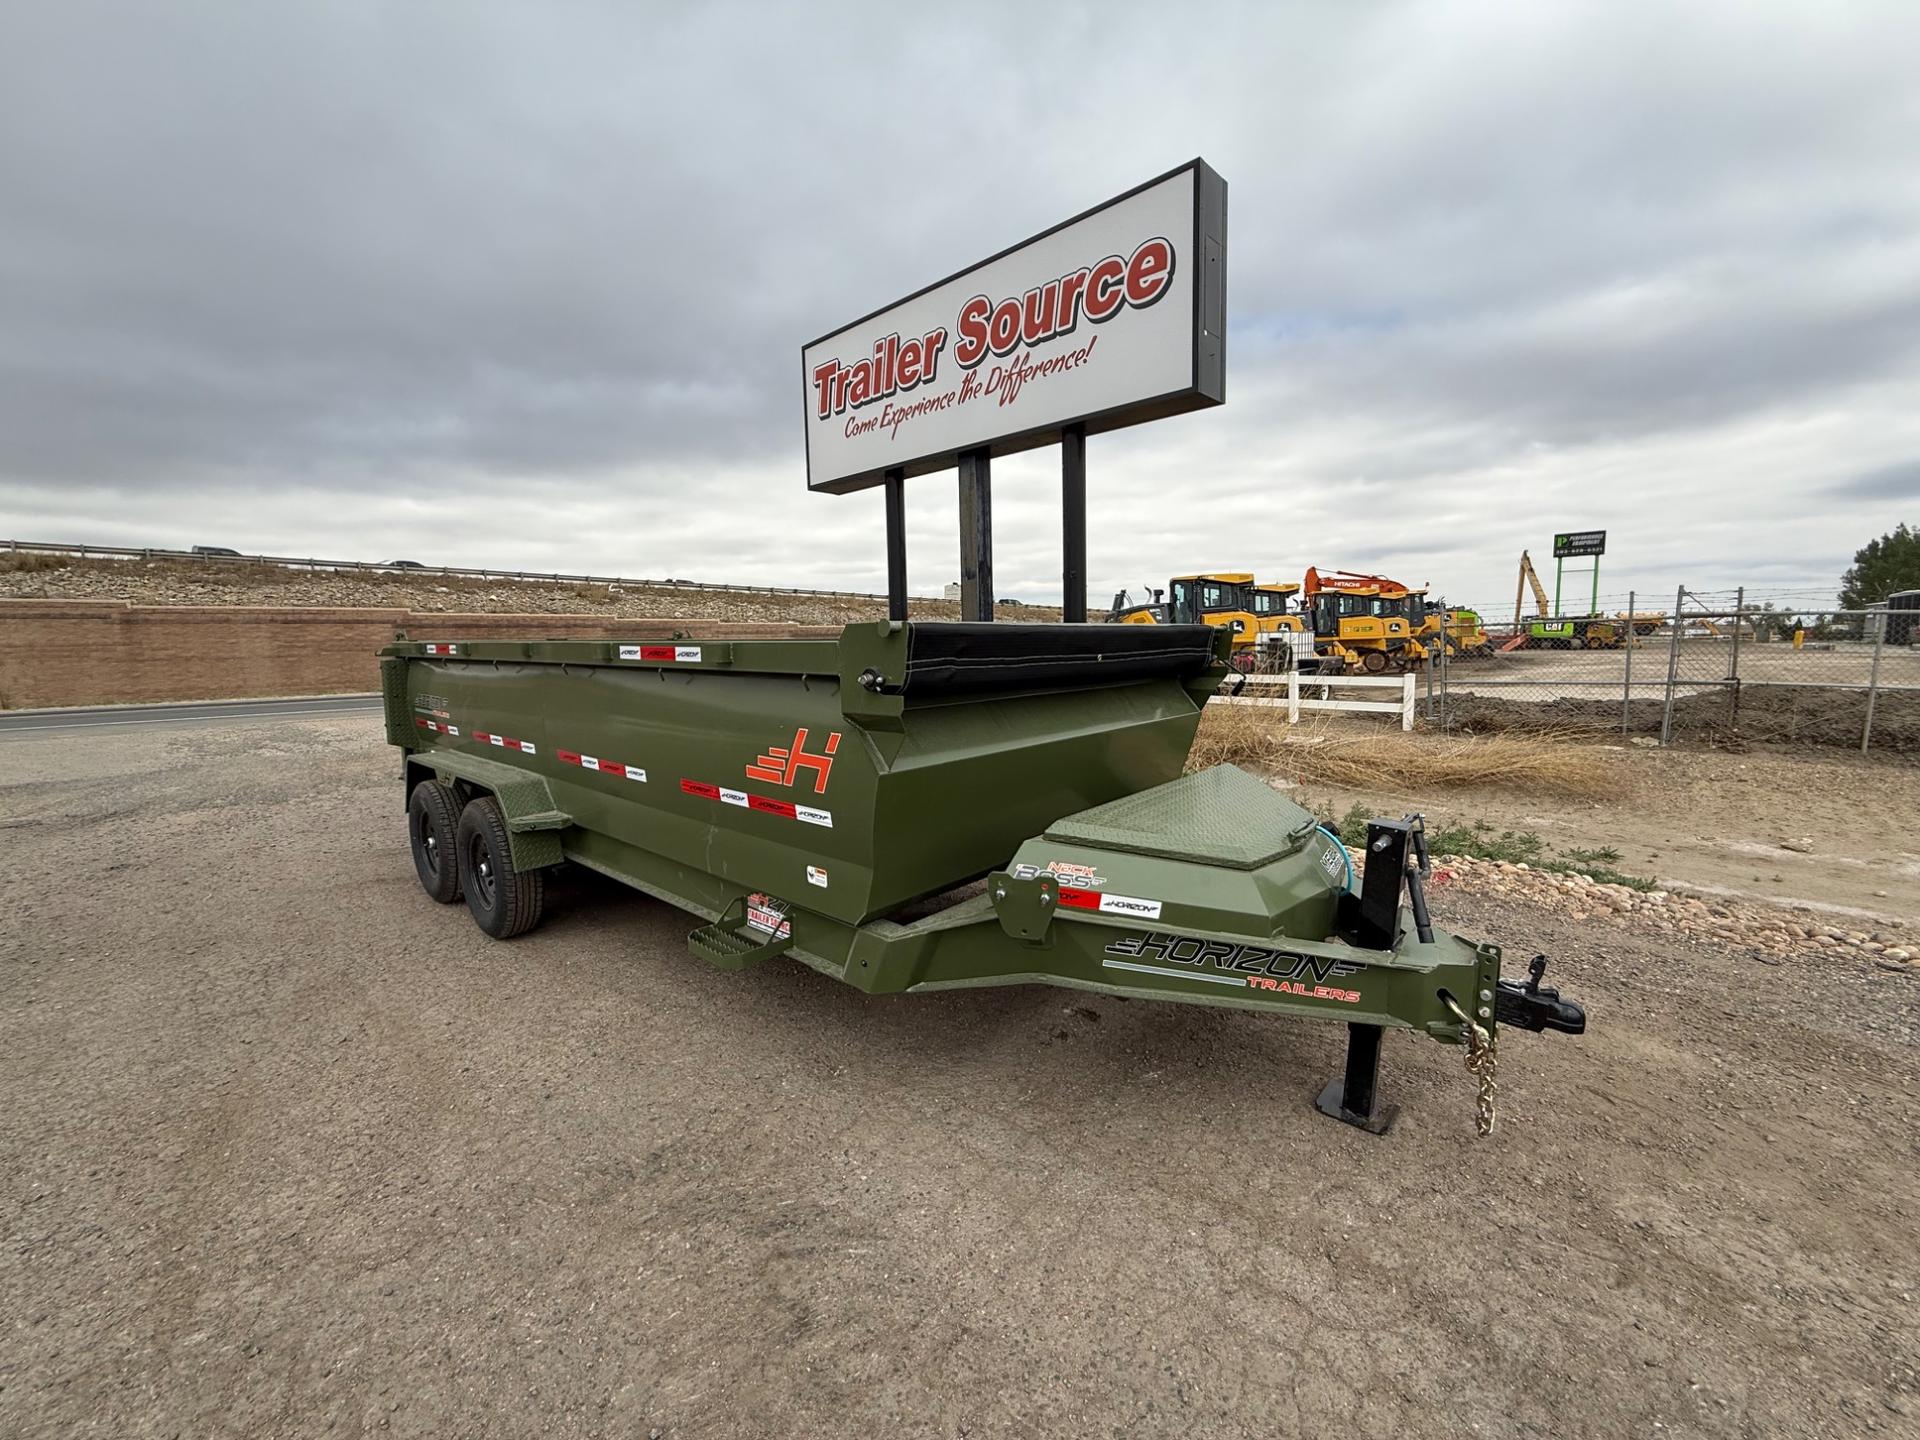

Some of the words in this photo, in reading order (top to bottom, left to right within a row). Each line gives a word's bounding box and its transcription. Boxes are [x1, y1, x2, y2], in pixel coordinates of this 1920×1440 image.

[814, 327, 946, 420] Trailer
[954, 237, 1176, 369] Source
[844, 416, 878, 440] Come
[880, 389, 956, 440] Experience
[958, 368, 983, 407] the
[984, 335, 1098, 408] Difference!
[1545, 623, 1563, 631] CAT
[1048, 862, 1096, 877] NECK
[1108, 900, 1154, 912] HORIZON
[1134, 931, 1340, 983] HORIZON
[1247, 976, 1361, 1003] TRAILERS
